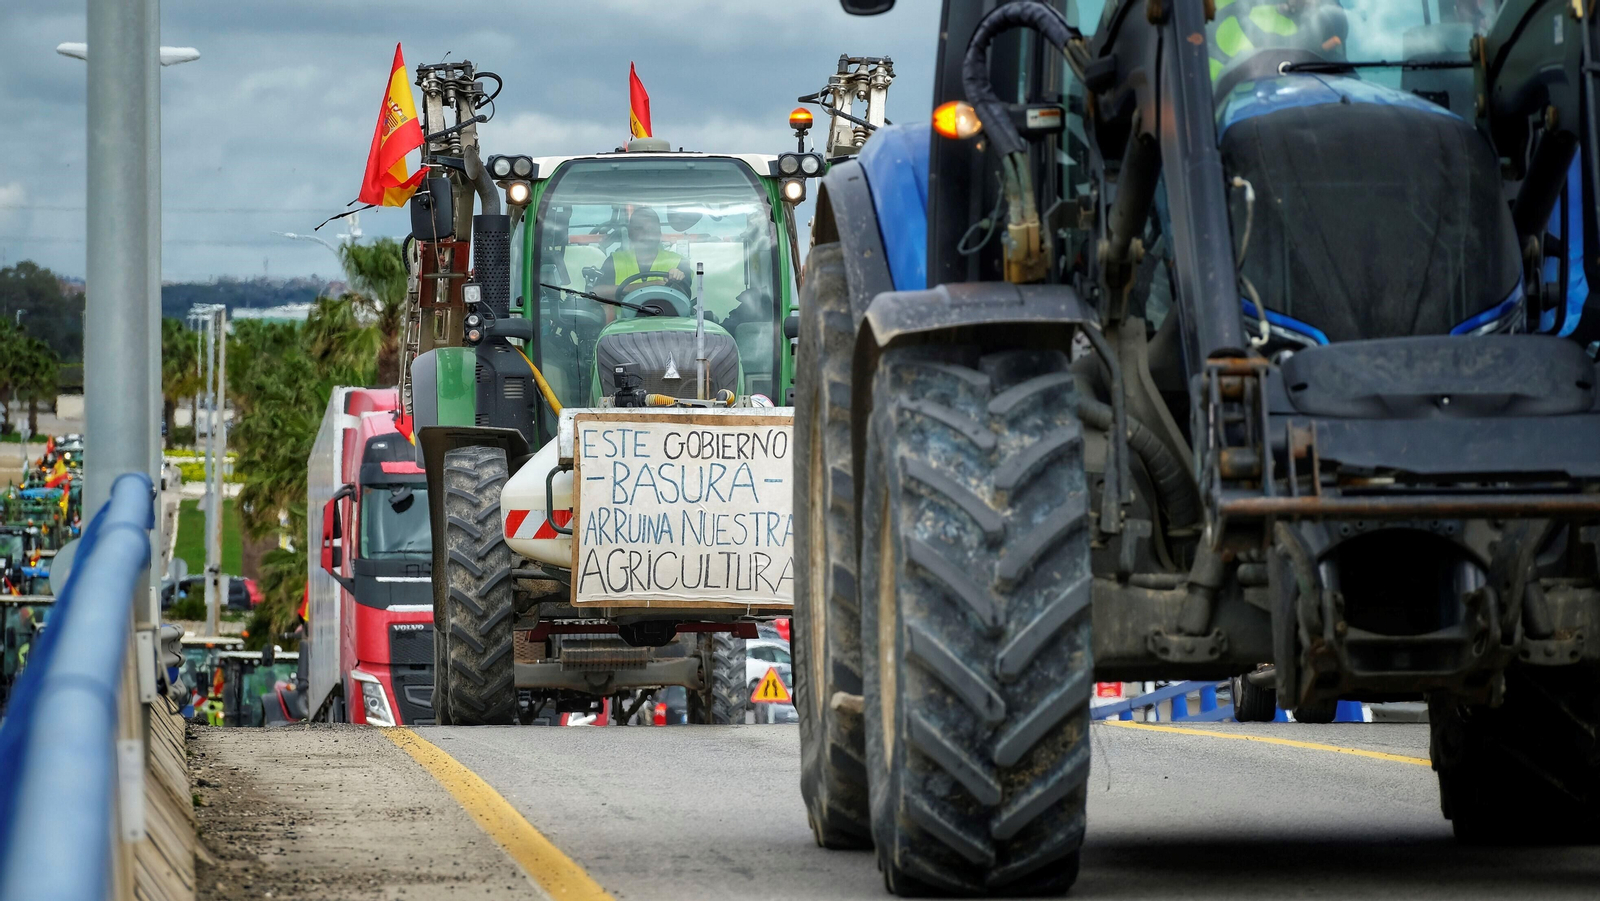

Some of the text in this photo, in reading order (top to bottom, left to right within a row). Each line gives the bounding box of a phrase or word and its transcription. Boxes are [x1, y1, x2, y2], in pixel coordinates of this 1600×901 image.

[583, 429, 788, 460] ESTE GOBIERNO
[584, 507, 794, 547] ARRUINA NUESTRA
